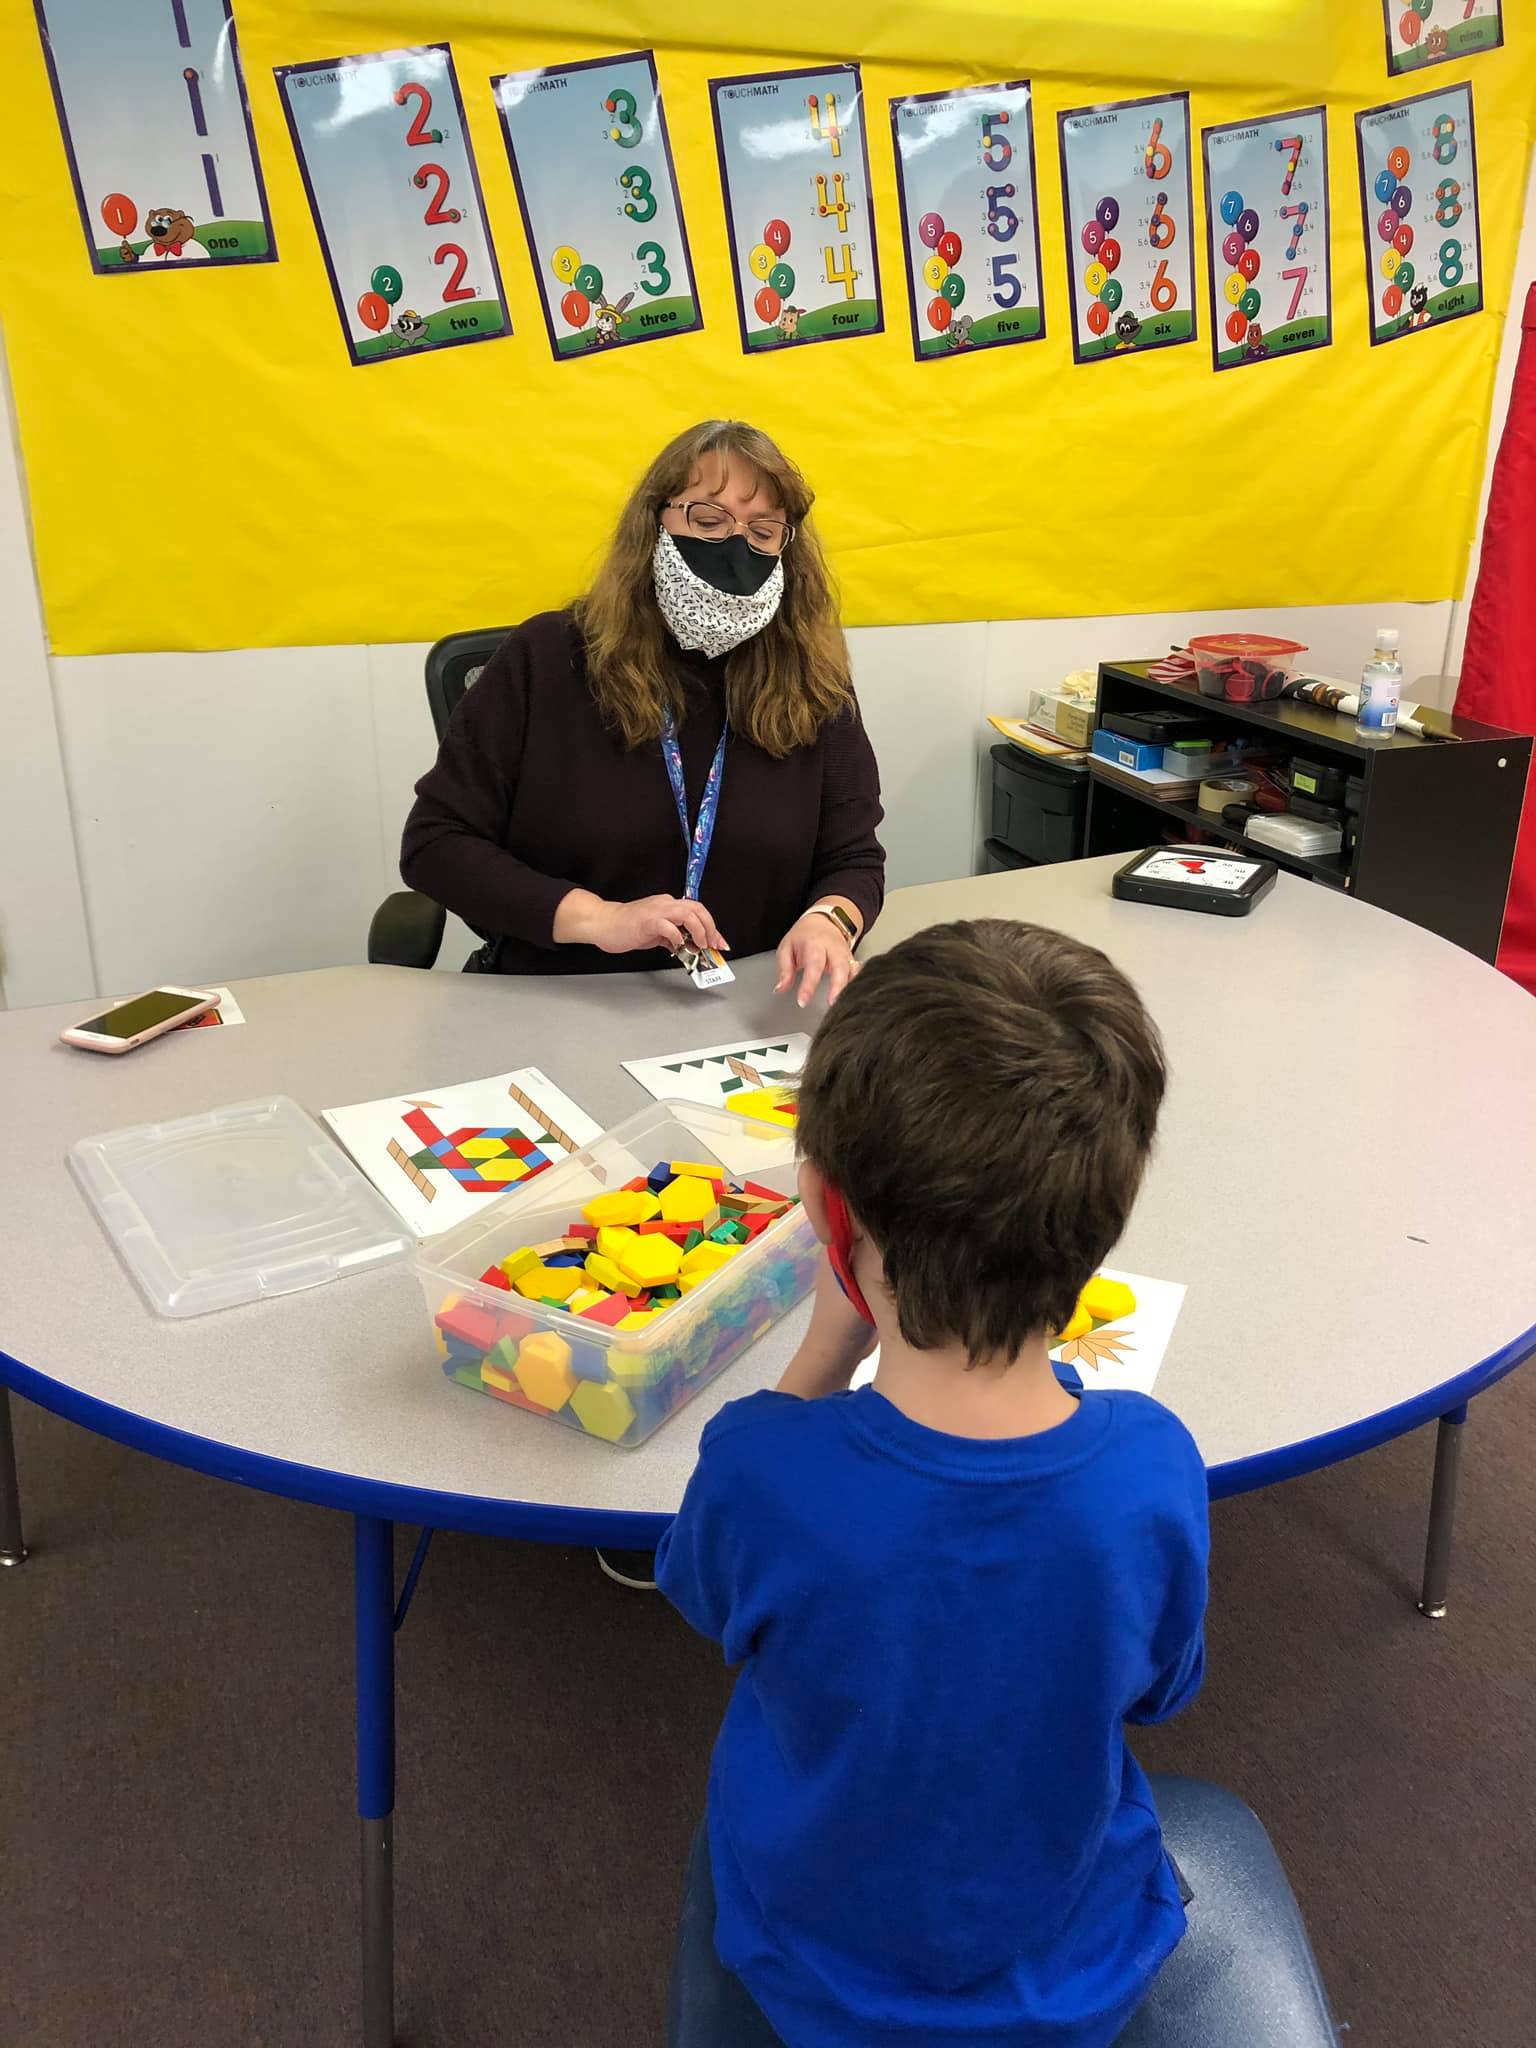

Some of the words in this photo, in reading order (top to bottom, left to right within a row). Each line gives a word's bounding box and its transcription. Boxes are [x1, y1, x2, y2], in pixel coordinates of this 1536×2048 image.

[1460, 30, 1484, 42] nine
[722, 85, 779, 100] TOUCHMATH
[393, 82, 443, 146] 2
[902, 102, 955, 118] TOUCHMATH
[1366, 108, 1410, 127] TOUCHMATH
[605, 89, 643, 149] 3
[808, 92, 844, 157] 4
[1069, 114, 1118, 130] TOUCHMATH
[982, 111, 1013, 172] 5
[1212, 129, 1260, 144] TOUCHMATH
[1432, 113, 1458, 165] 8
[1145, 117, 1173, 180] 6
[1274, 134, 1304, 196] 7
[1395, 156, 1403, 169] 8
[1382, 179, 1388, 192] 7
[413, 163, 461, 225] 2
[620, 165, 657, 223] 3
[1398, 195, 1405, 208] 6
[816, 172, 851, 233] 4
[1228, 200, 1235, 214] 7
[1435, 177, 1463, 228] 8
[116, 208, 124, 224] 1
[986, 183, 1019, 242] 5
[1104, 207, 1112, 221] 6
[1149, 192, 1176, 250] 6
[1245, 218, 1252, 232] 6
[1385, 219, 1391, 232] 5
[773, 230, 782, 245] 4
[927, 223, 936, 237] 5
[1089, 231, 1097, 244] 5
[1280, 202, 1308, 260] 7
[207, 237, 239, 251] one
[1400, 233, 1407, 246] 4
[946, 242, 954, 256] 4
[1106, 248, 1114, 261] 4
[1230, 242, 1237, 255] 5
[561, 257, 572, 272] 3
[636, 241, 671, 296] 3
[758, 255, 767, 270] 3
[1246, 258, 1253, 271] 4
[1387, 257, 1394, 270] 3
[1439, 238, 1464, 288] 8
[434, 243, 476, 302] 2
[824, 244, 858, 300] 4
[932, 266, 940, 279] 3
[1092, 271, 1100, 284] 3
[1402, 271, 1409, 283] 2
[382, 277, 394, 292] 2
[585, 275, 595, 290] 2
[778, 274, 788, 288] 2
[992, 253, 1022, 309] 5
[1151, 259, 1177, 312] 6
[1232, 281, 1239, 295] 3
[949, 284, 958, 297] 2
[1108, 288, 1116, 301] 2
[1282, 266, 1308, 320] 7
[573, 303, 579, 317] 1
[765, 299, 770, 313] 1
[1247, 297, 1254, 311] 2
[1438, 294, 1465, 311] eight
[370, 306, 378, 320] 1
[640, 311, 677, 327] three
[831, 313, 860, 326] four
[937, 308, 942, 321] 1
[450, 316, 479, 331] two
[997, 320, 1020, 334] five
[1154, 323, 1171, 336] six
[1282, 328, 1315, 343] seven
[705, 976, 721, 985] STAFF
